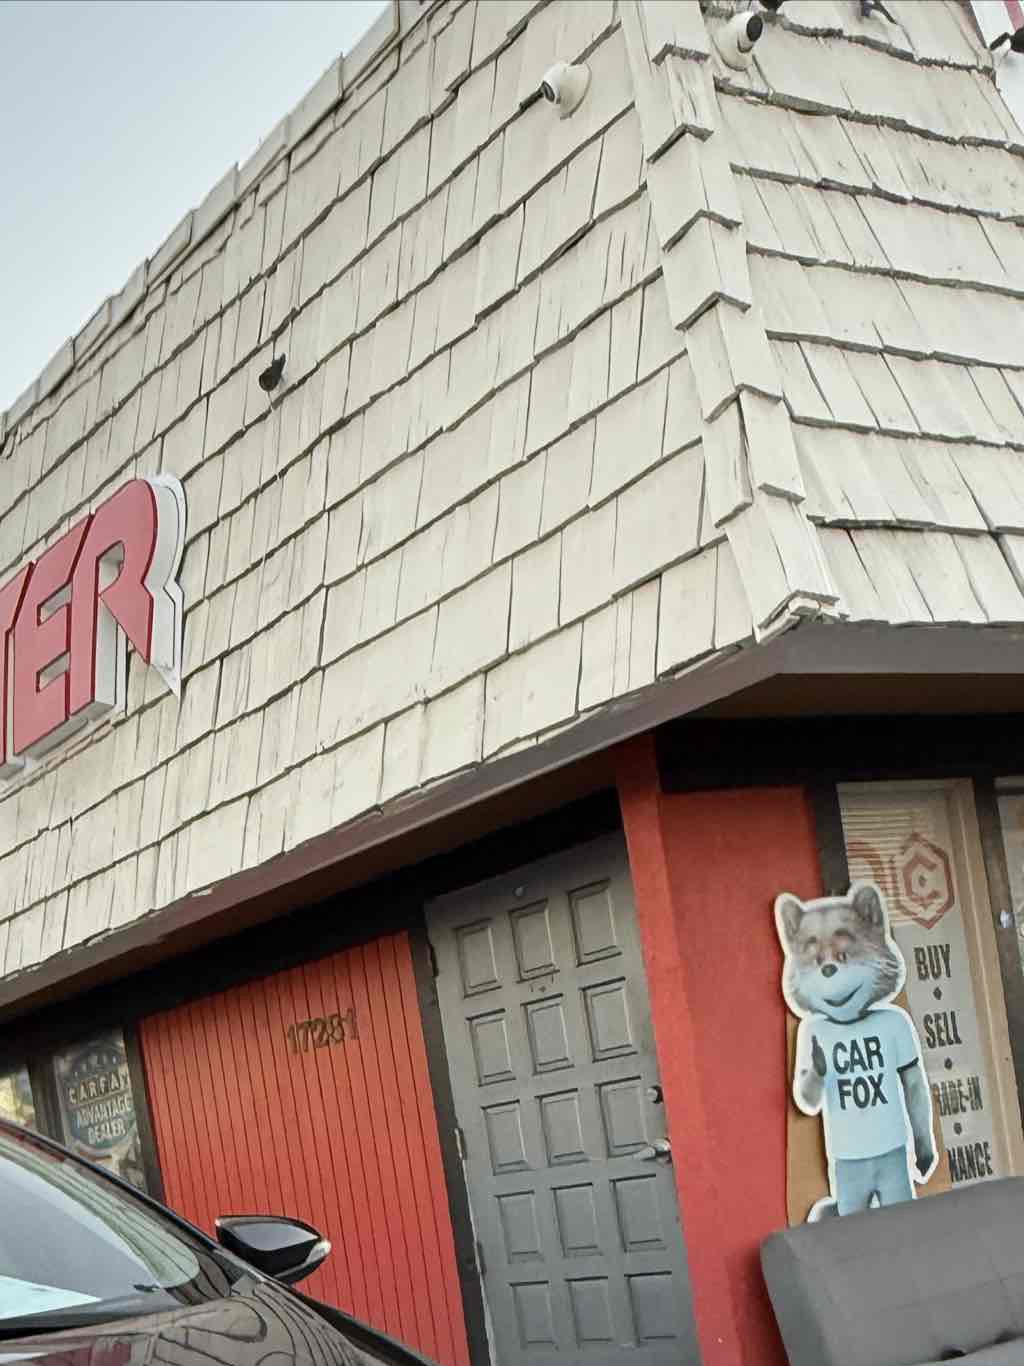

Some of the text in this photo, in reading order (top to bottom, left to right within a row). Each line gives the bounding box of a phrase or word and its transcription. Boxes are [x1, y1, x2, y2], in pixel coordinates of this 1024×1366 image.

[914, 943, 951, 981] BUY
[287, 1007, 361, 1054] 17281
[923, 1010, 962, 1049] SELL
[832, 1035, 885, 1075] CAR
[837, 1072, 889, 1110] FOX
[931, 1075, 983, 1116] RADE-IN
[87, 1117, 126, 1145] DEALER
[946, 1141, 993, 1182] NANCE
